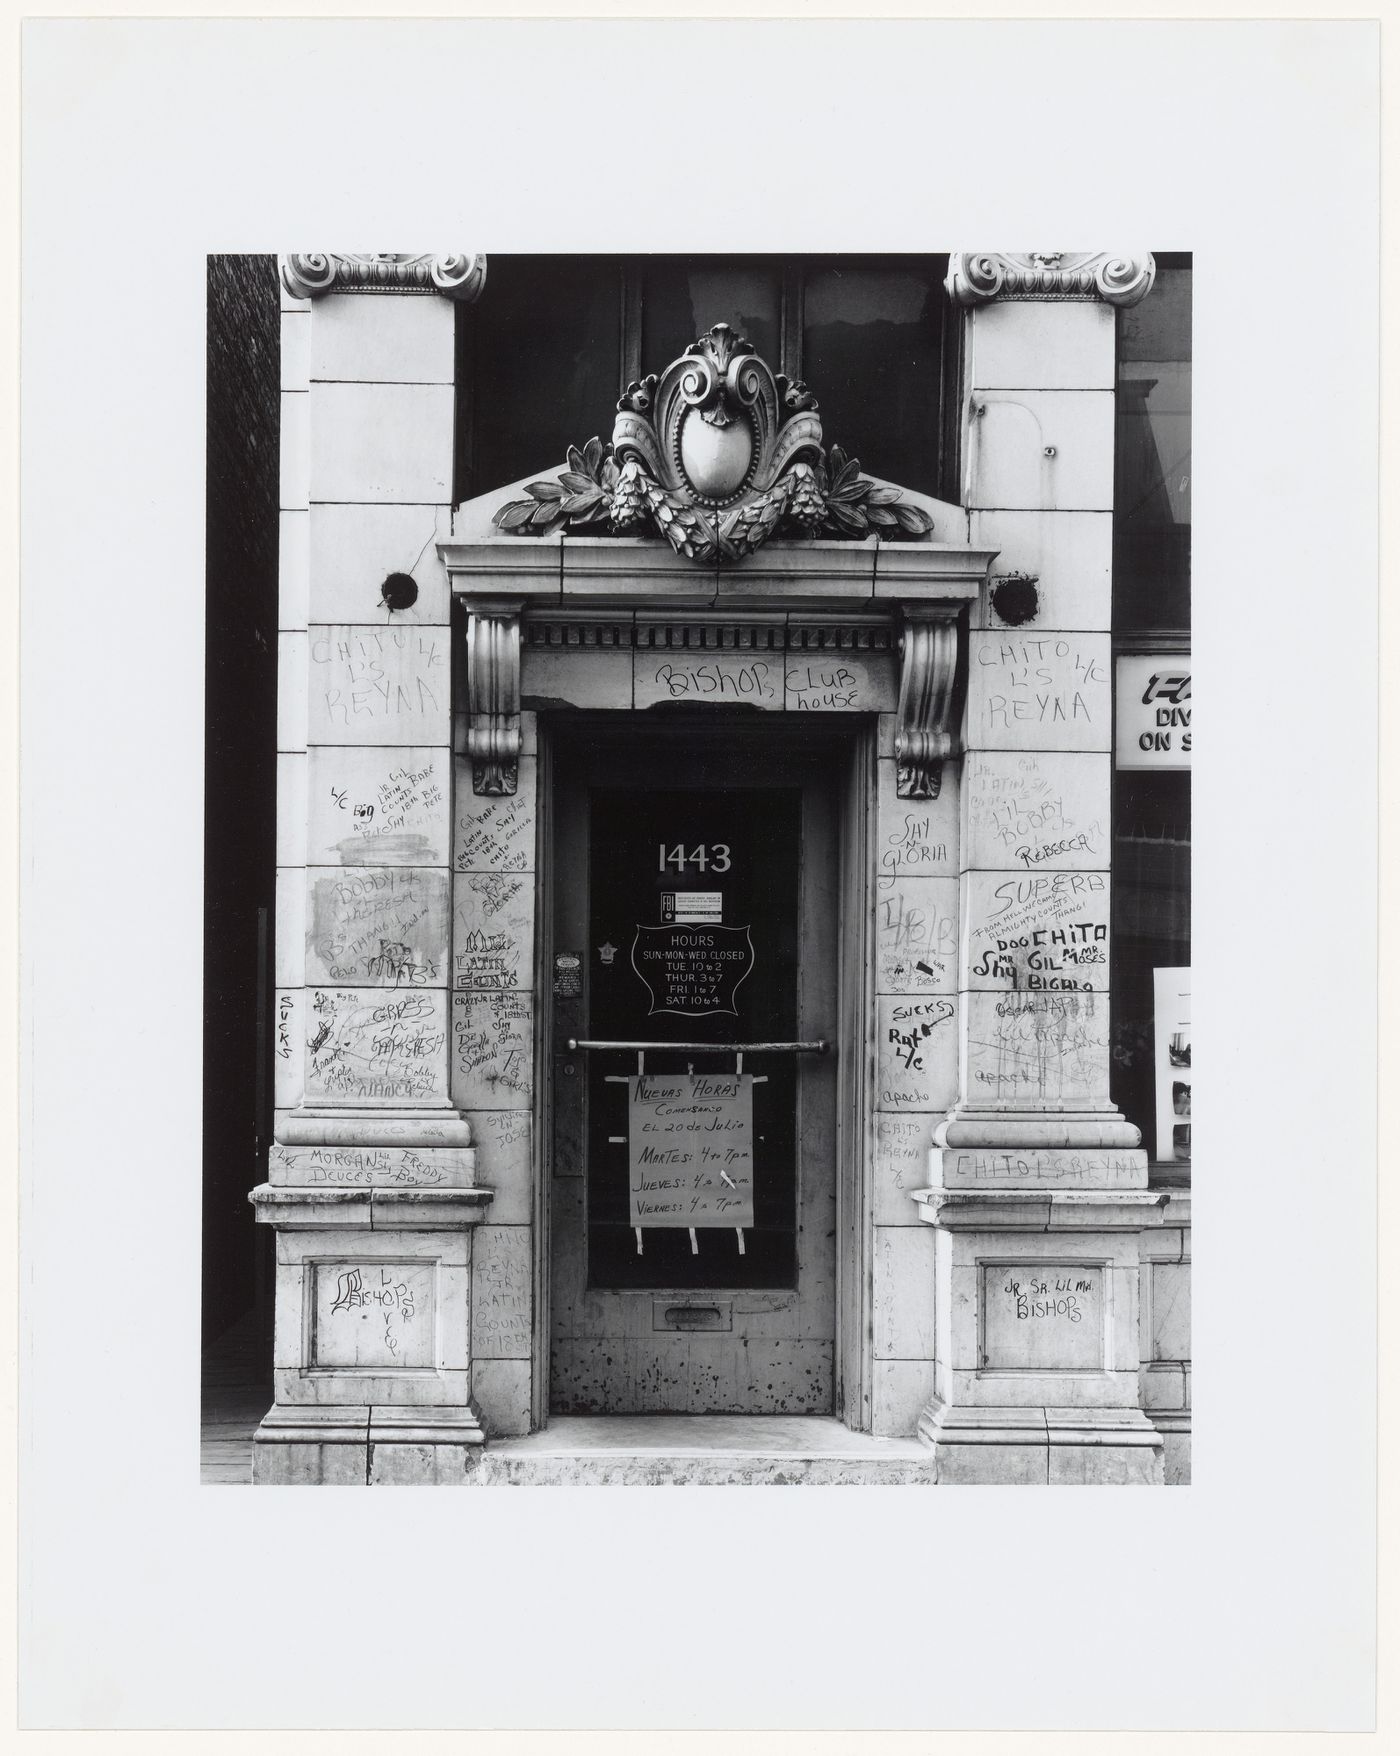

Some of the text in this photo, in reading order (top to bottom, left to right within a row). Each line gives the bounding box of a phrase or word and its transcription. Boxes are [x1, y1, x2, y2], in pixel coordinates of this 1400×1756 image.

[325, 676, 438, 726] REYNA
[989, 692, 1091, 728] REYNA
[1139, 731, 1171, 751] ON
[331, 786, 348, 809] L/C
[378, 785, 401, 805] LATIN
[889, 814, 929, 845] SHY
[659, 844, 732, 872] 1443
[662, 895, 674, 911] FBI
[986, 874, 1105, 919] SUPERB
[988, 896, 1069, 940] ALMIGHTY COUNTS
[972, 921, 1002, 939] FROM
[671, 935, 714, 946] HOURS
[710, 950, 745, 960] CLOSED
[1028, 950, 1063, 971] GIL
[692, 962, 704, 971] 10
[715, 962, 722, 971] 2
[665, 974, 697, 982] THUR.
[700, 974, 707, 982] 3
[716, 974, 723, 982] 7
[710, 985, 716, 993] 7
[691, 996, 702, 1005] 10
[712, 996, 721, 1005] 4
[893, 1000, 946, 1022] SUCKS
[634, 1079, 740, 1102] NUEVAS HORAS
[642, 1123, 659, 1132] EL
[665, 1123, 683, 1132] 20
[638, 1146, 693, 1165] MARTES:
[702, 1147, 710, 1163] 4
[308, 1166, 374, 1183] DEUCES
[310, 1150, 377, 1170] MORGAN
[402, 1150, 448, 1184] FREDDY
[956, 1155, 1029, 1179] CHITO
[1071, 1155, 1140, 1180] REYNA
[632, 1172, 686, 1192] JUEVES:
[694, 1173, 703, 1189] 4
[690, 1197, 700, 1213] 4
[1030, 1279, 1050, 1294] SR.
